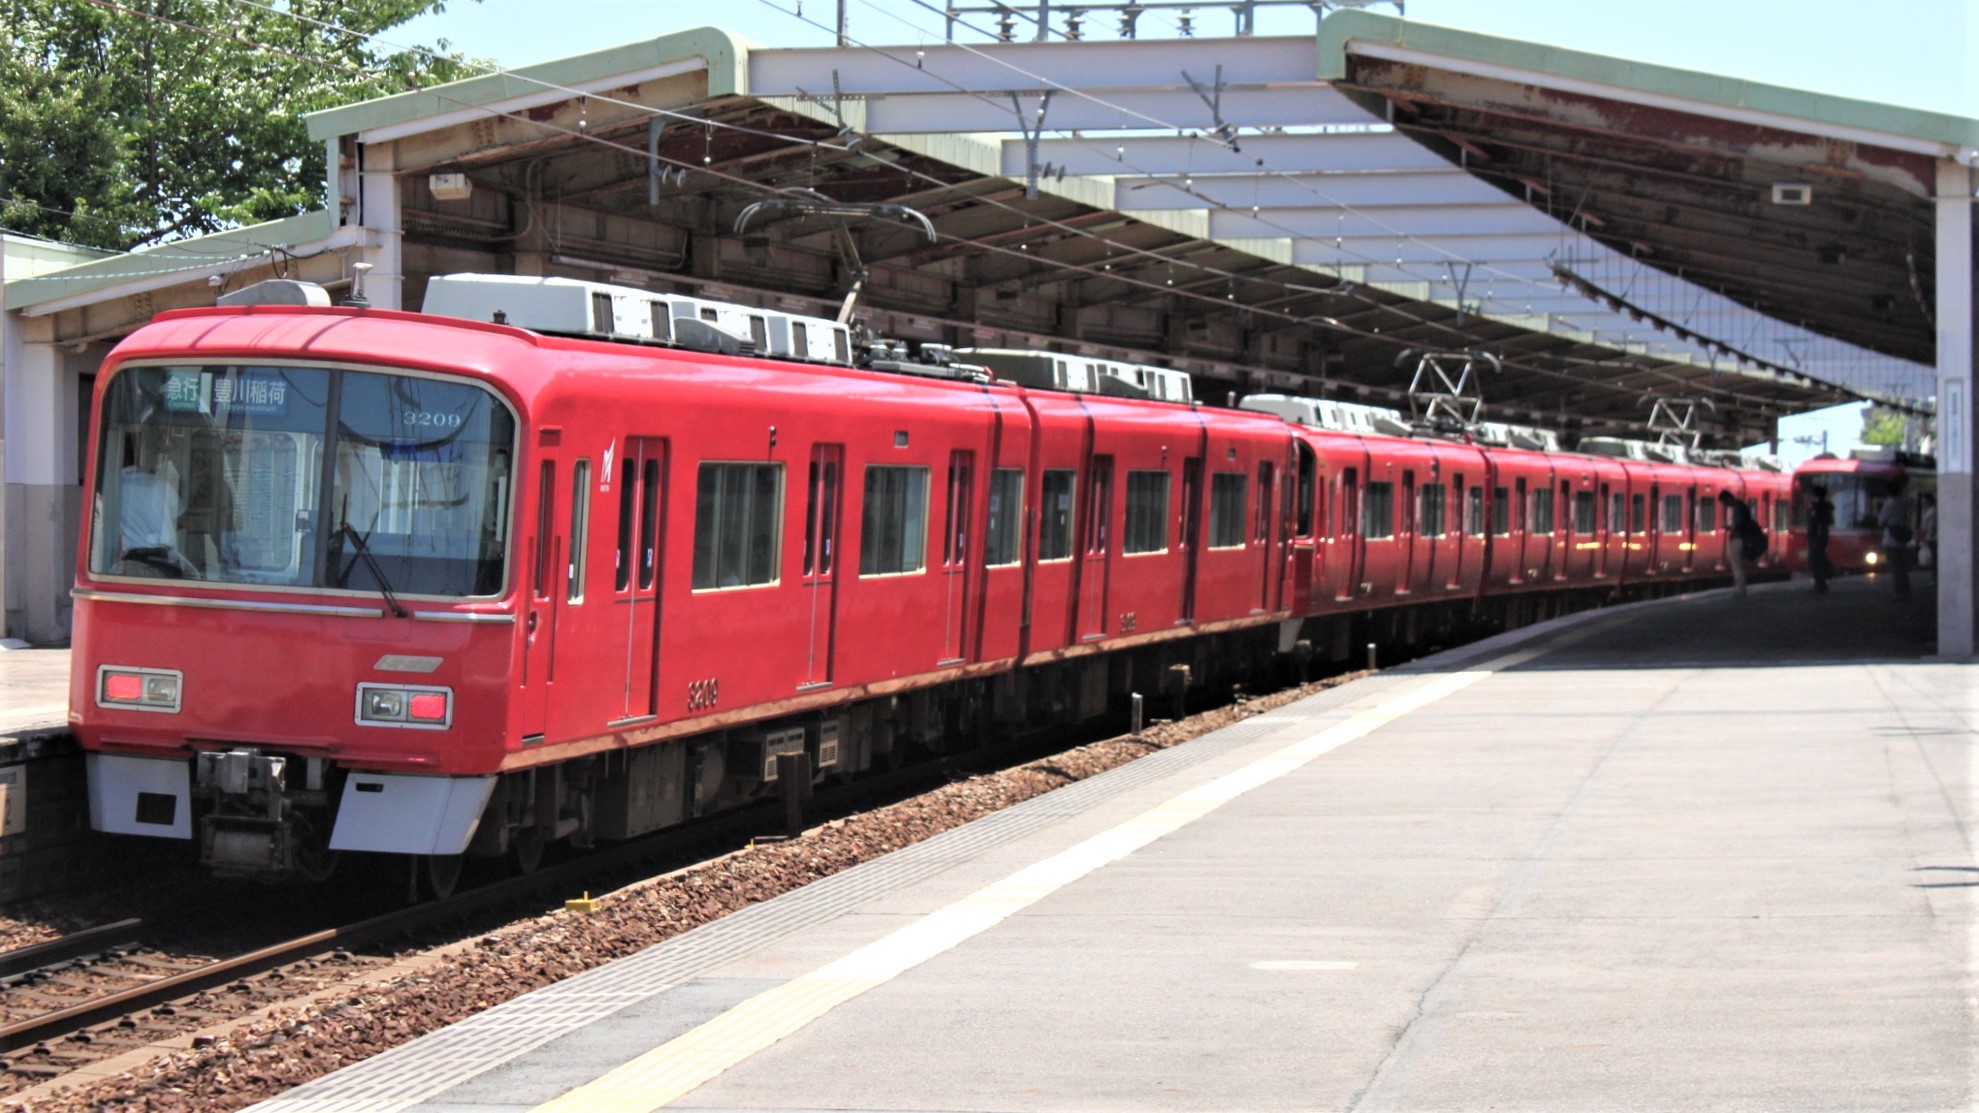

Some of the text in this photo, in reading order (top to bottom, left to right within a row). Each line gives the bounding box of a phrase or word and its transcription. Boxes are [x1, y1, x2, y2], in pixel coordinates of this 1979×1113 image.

[167, 376, 199, 401] 急行
[403, 411, 461, 427] 3209
[688, 678, 718, 712] 3209
